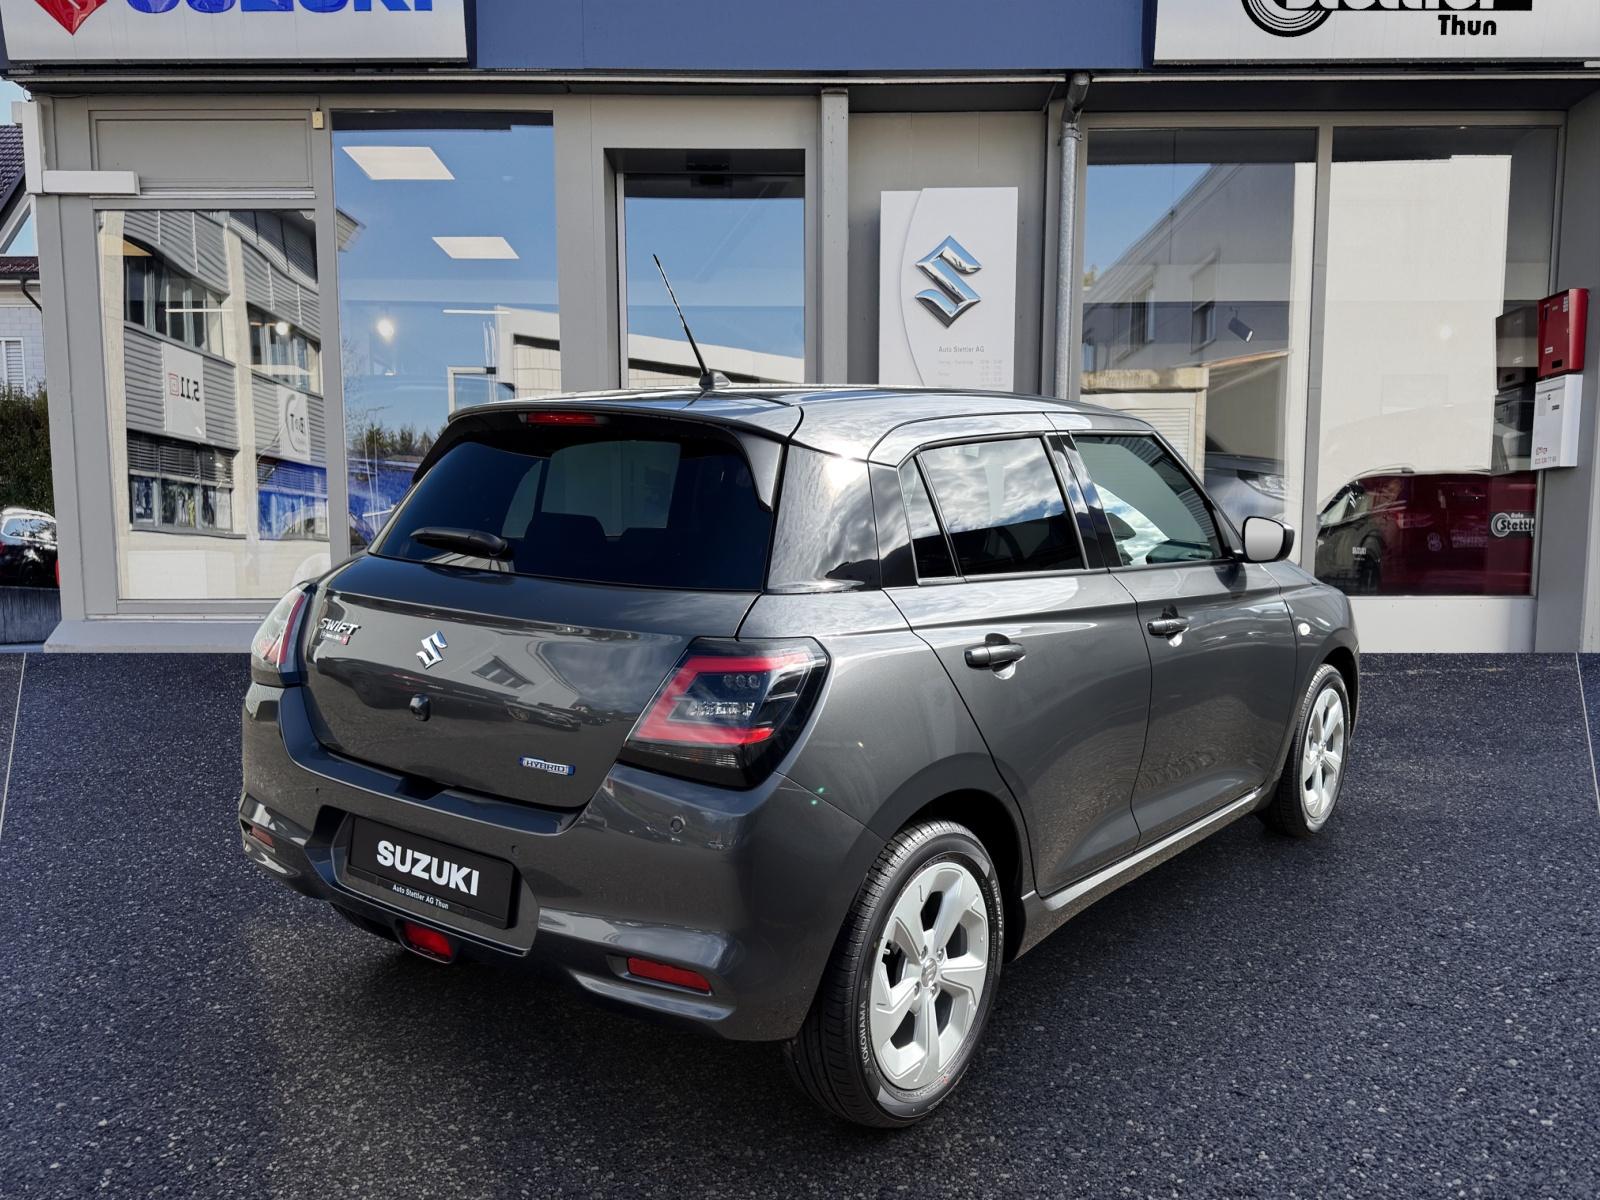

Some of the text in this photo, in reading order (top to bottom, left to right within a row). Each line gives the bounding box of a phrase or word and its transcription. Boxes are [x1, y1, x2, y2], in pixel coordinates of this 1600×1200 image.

[1438, 15, 1497, 36] Thun
[938, 345, 952, 353] Auto
[975, 345, 985, 353] AG
[319, 617, 359, 636] SWIFT
[525, 760, 566, 773] HYBRID
[376, 840, 480, 897] SUZUKI
[392, 884, 449, 910] Auto Stettler AG Thun
[859, 1000, 870, 1065] YOKOHAMA
